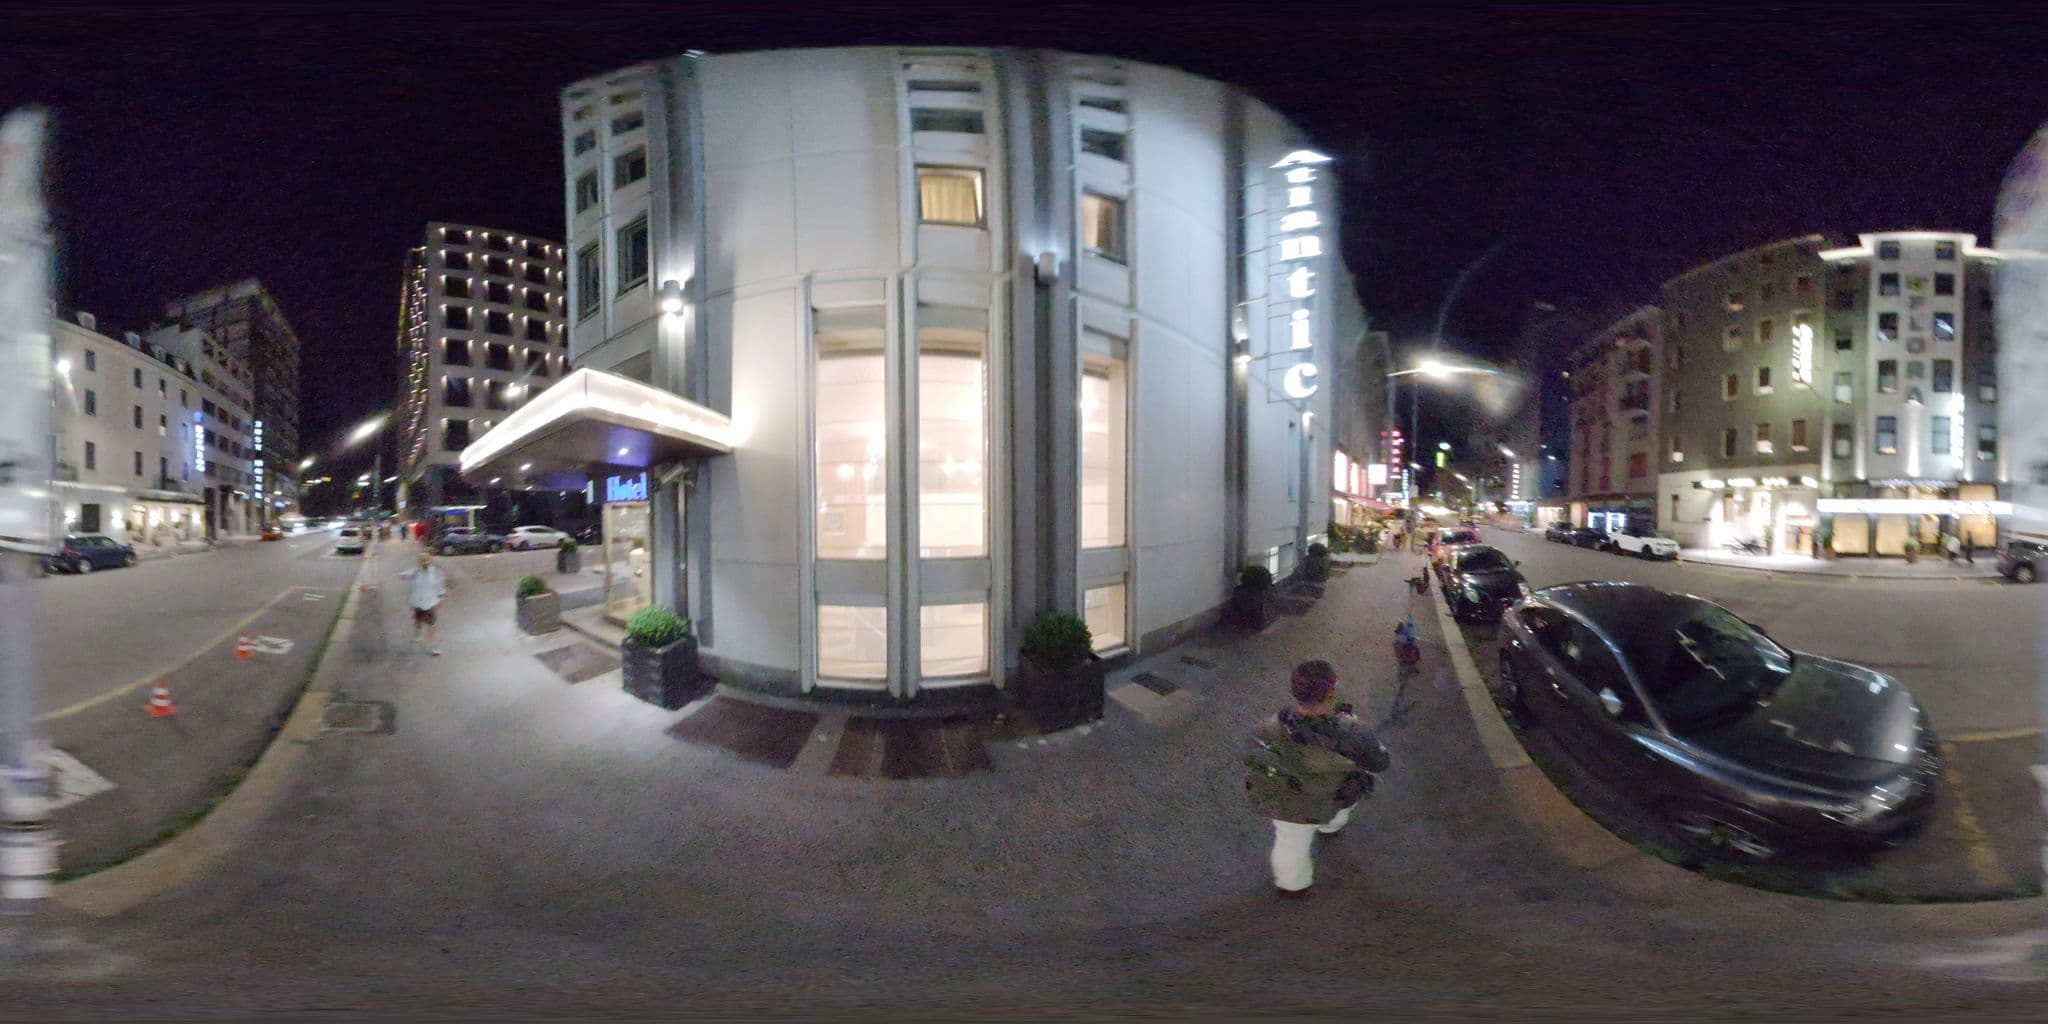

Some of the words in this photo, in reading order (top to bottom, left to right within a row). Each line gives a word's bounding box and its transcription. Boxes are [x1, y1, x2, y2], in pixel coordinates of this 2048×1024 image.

[1269, 150, 1333, 398] Atlantic
[1906, 295, 1925, 403] FLORA
[606, 472, 647, 501] Hotel
